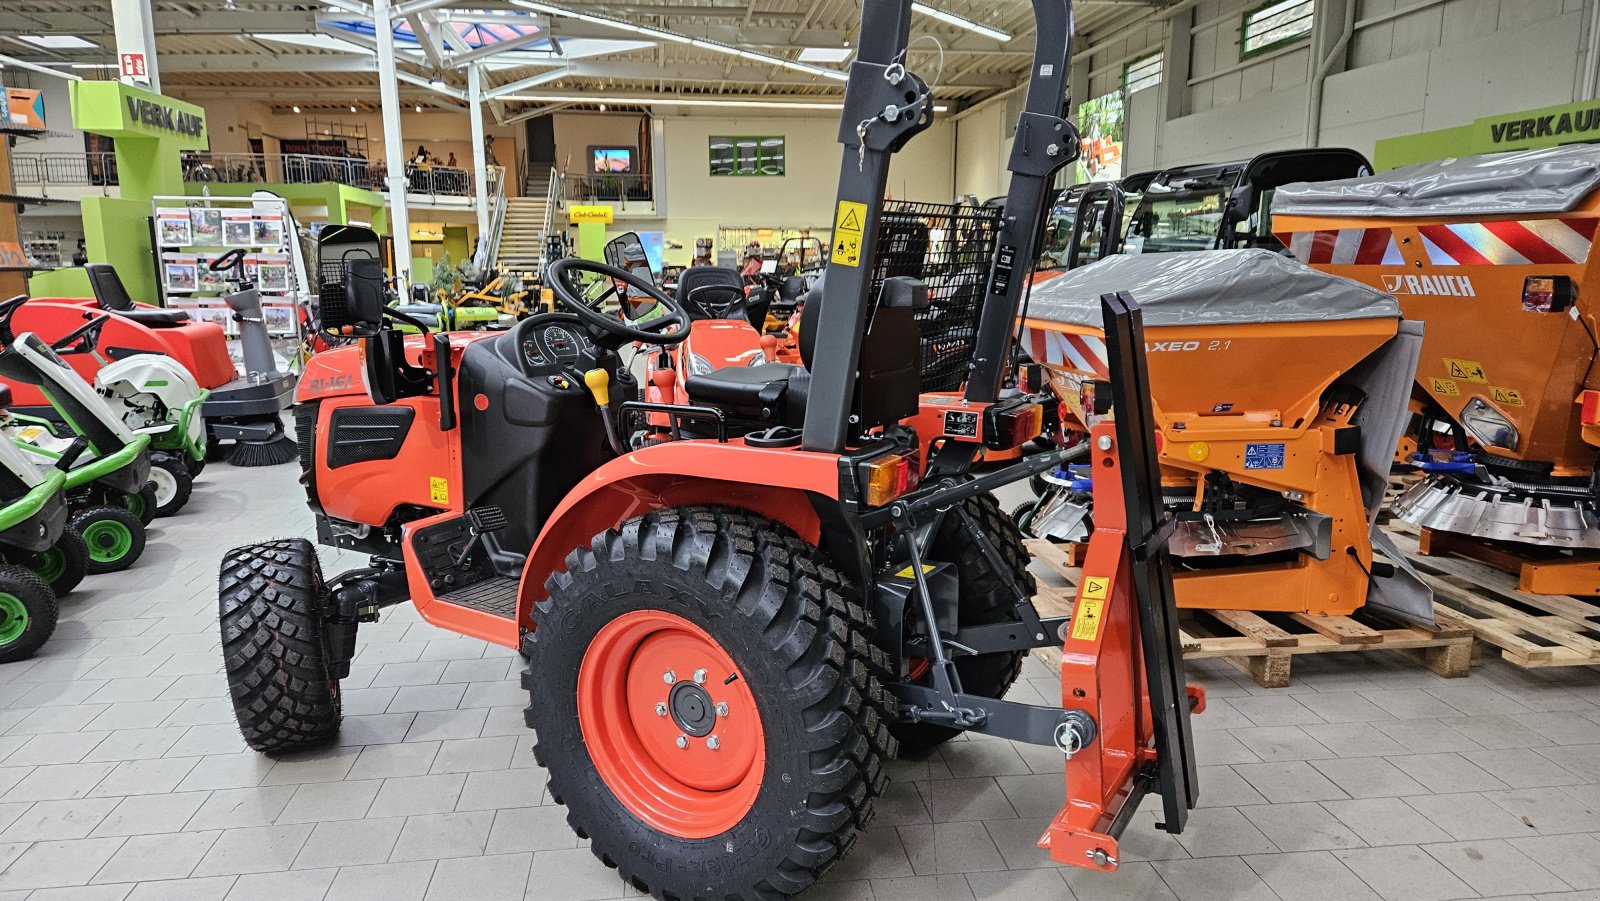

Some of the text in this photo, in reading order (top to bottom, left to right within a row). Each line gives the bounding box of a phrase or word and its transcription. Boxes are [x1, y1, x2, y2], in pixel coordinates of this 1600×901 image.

[126, 95, 203, 138] VERKAUF
[1491, 108, 1600, 144] VERKAUF
[1404, 275, 1476, 297] RAUCH
[1207, 340, 1232, 351] 2.1
